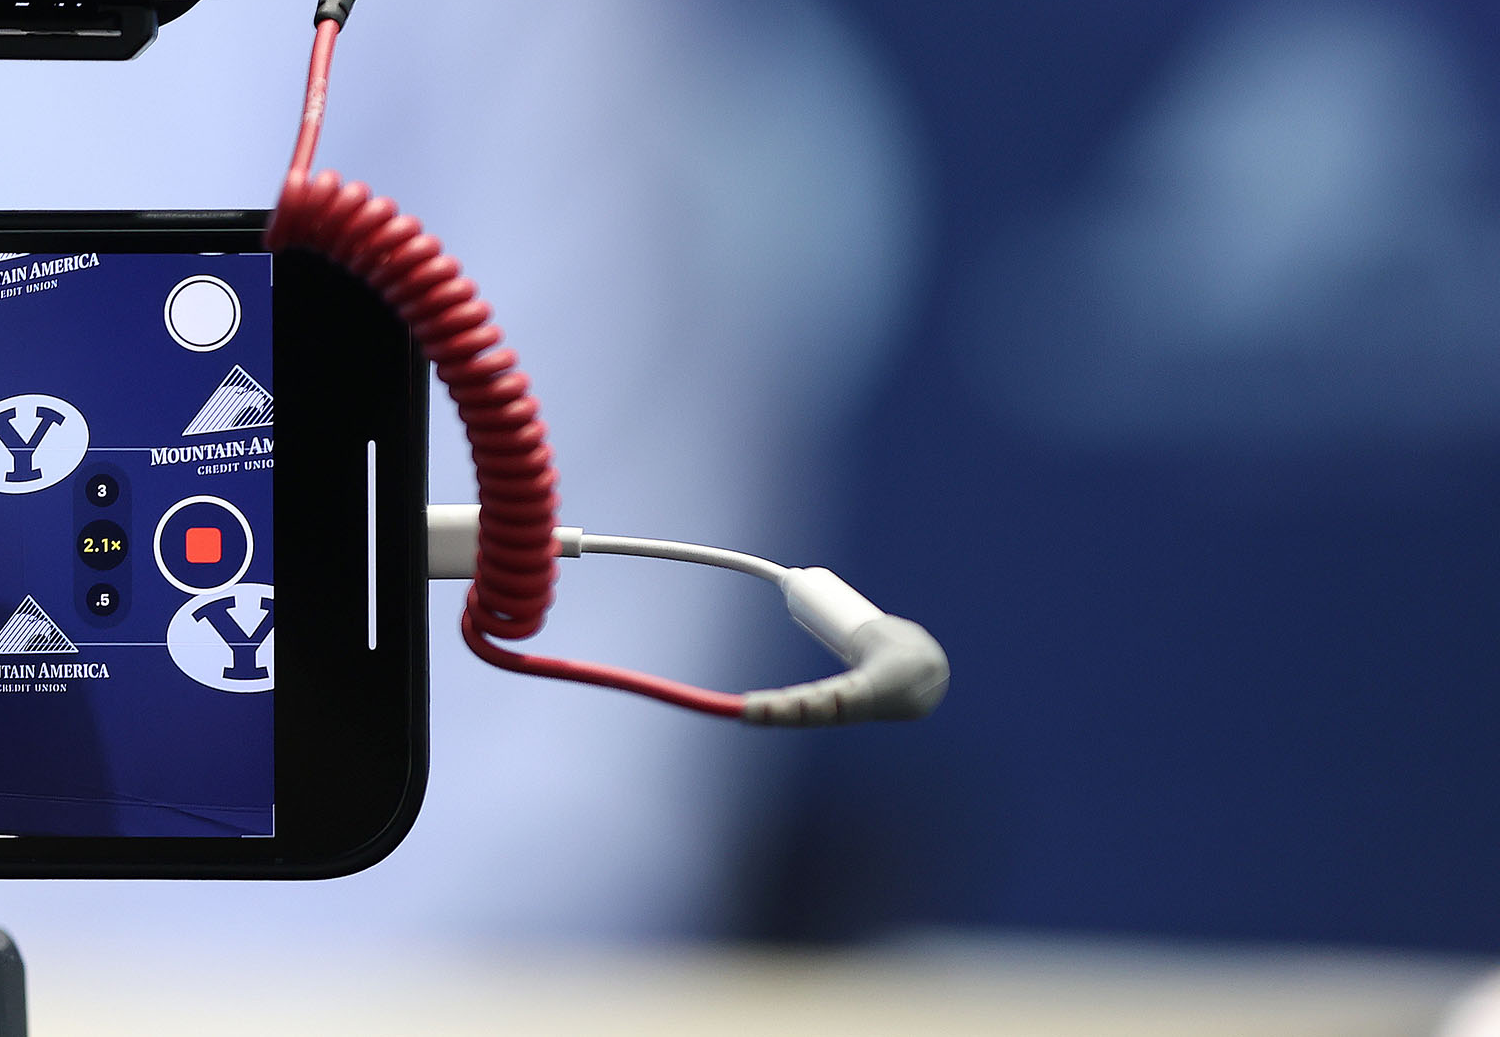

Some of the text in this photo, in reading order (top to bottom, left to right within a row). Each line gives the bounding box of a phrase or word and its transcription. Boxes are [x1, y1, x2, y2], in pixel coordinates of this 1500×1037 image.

[29, 253, 100, 279] AMERICA
[26, 279, 58, 294] UNION
[150, 440, 246, 466] MOUNTAIN
[197, 462, 240, 475] CREDIT
[97, 484, 107, 498] 3
[96, 594, 110, 607] .5
[191, 595, 274, 681] Y
[38, 662, 110, 679] AMERICA
[34, 683, 67, 693] UNION
